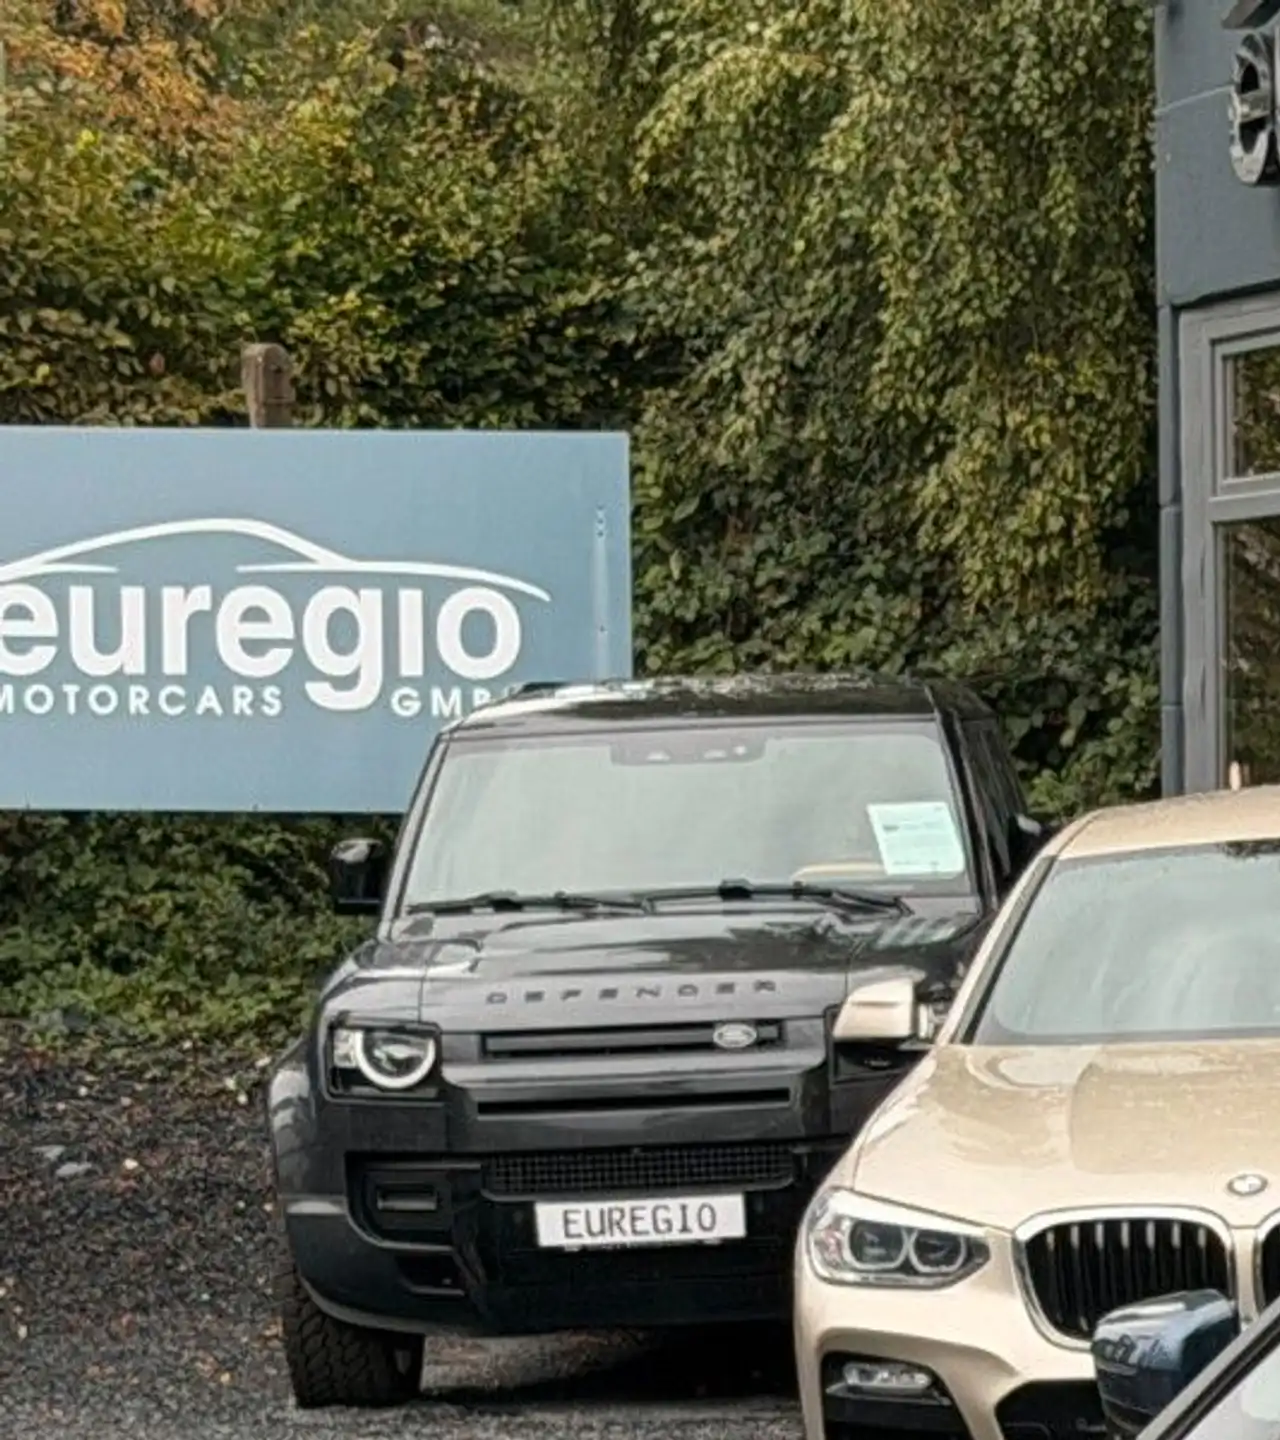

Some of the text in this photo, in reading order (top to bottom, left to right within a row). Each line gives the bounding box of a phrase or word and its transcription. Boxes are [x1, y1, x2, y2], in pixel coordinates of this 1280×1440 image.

[0, 583, 522, 710] euregio
[391, 685, 516, 718] GMB
[485, 978, 777, 1005] DEFENDER
[562, 1202, 718, 1240] EUREGIO
